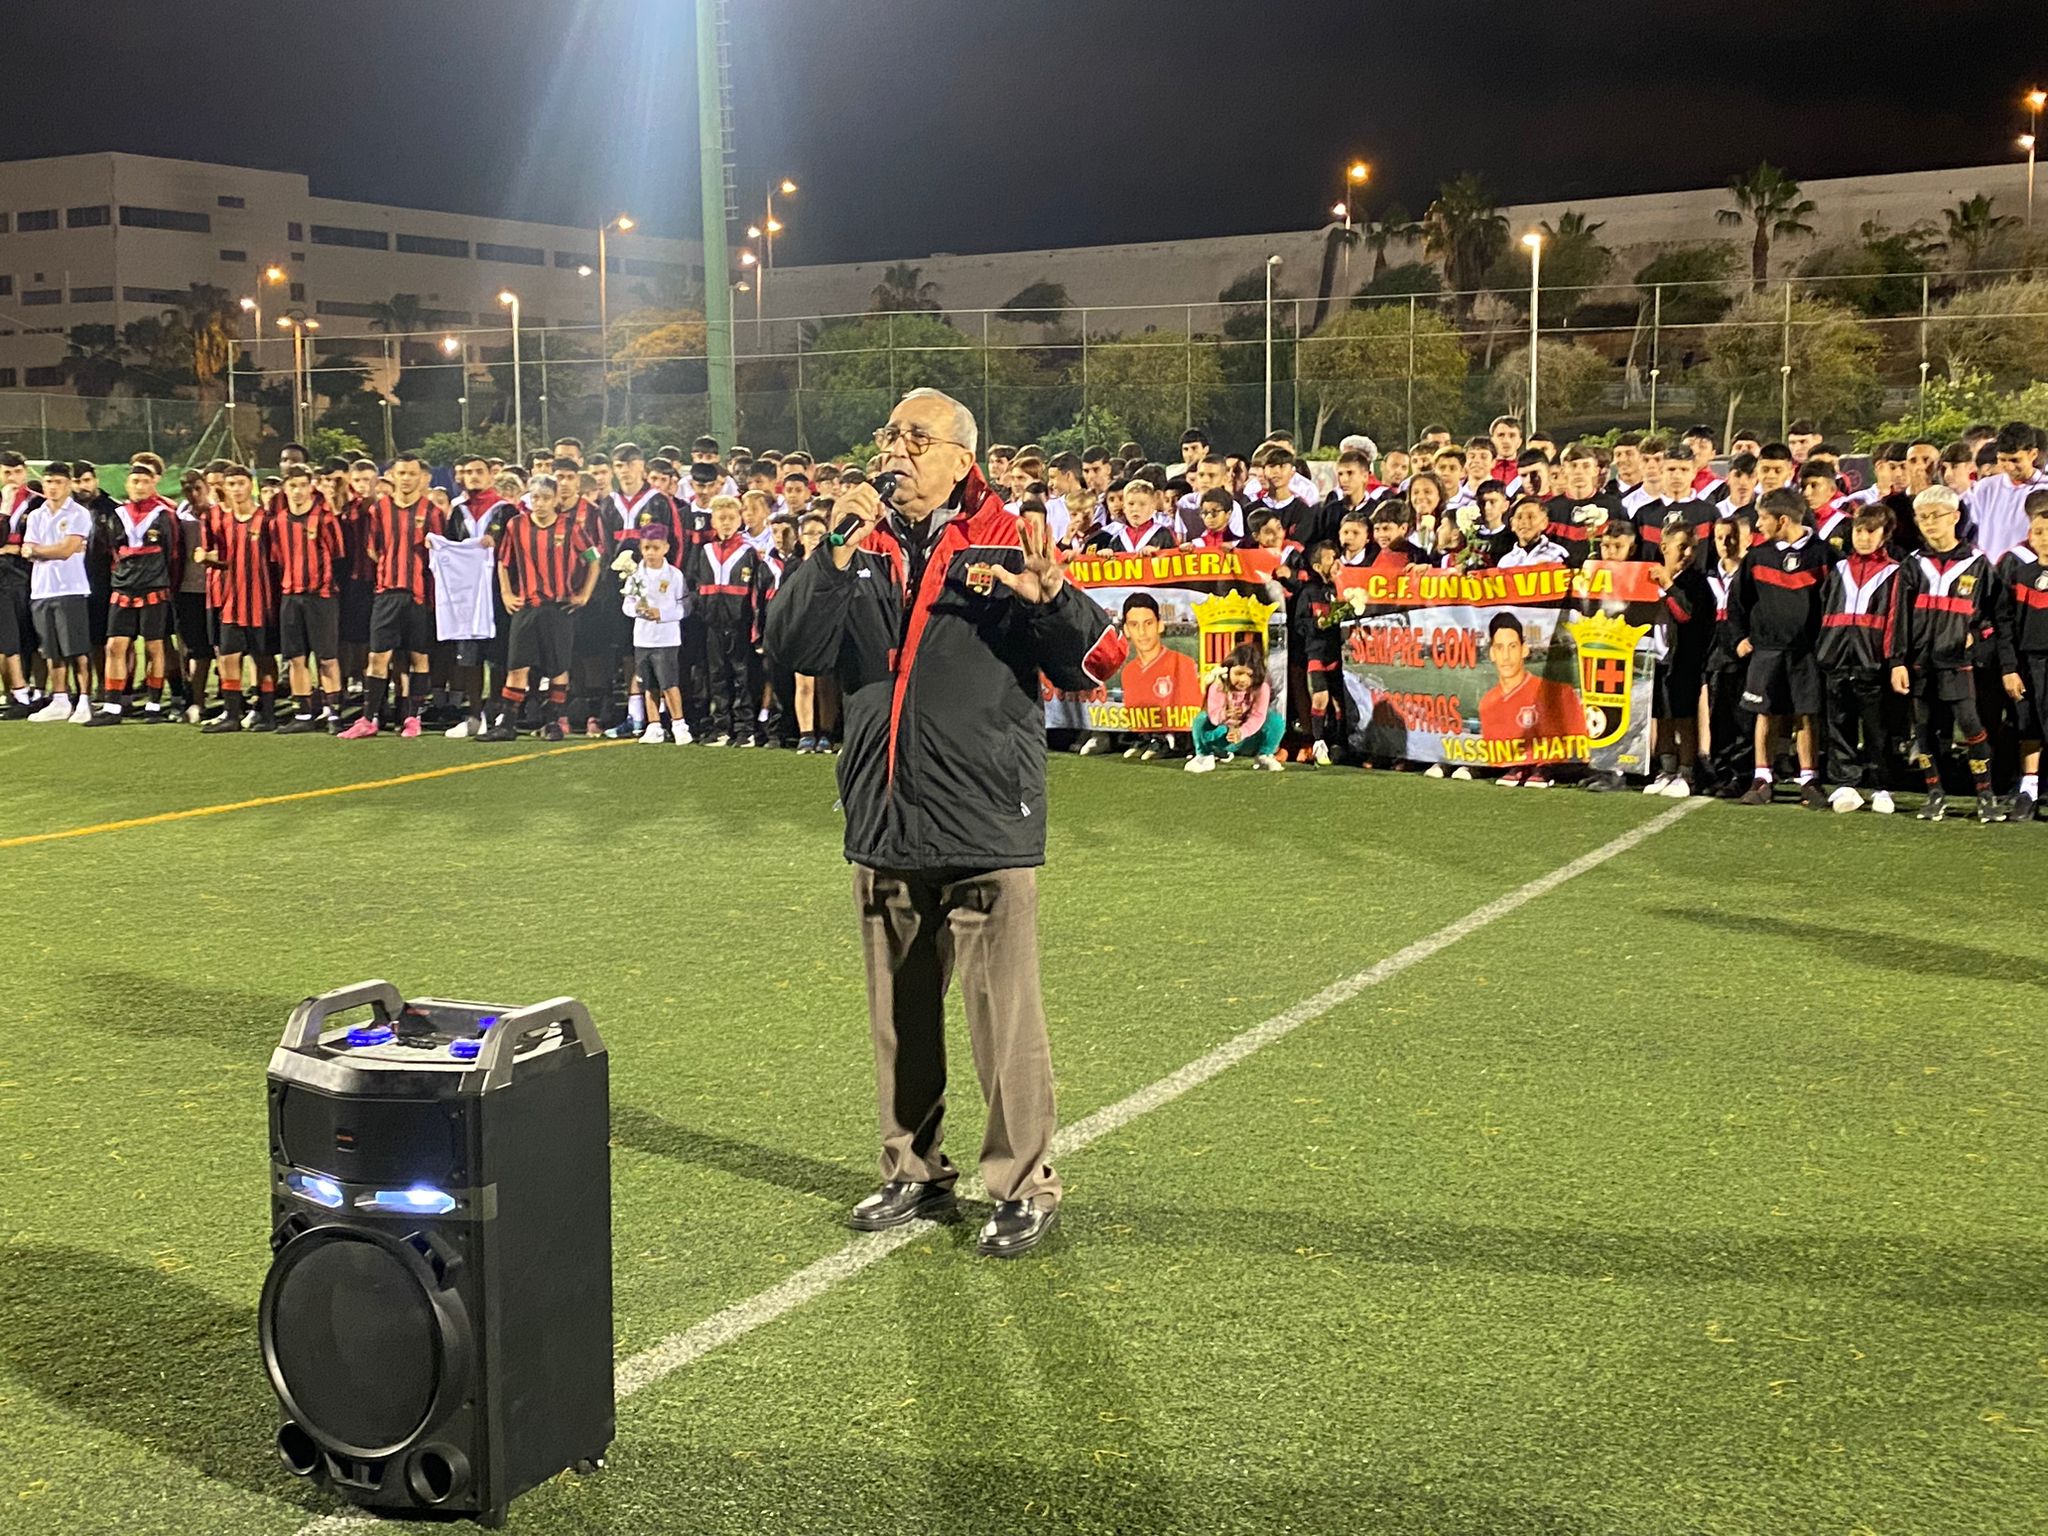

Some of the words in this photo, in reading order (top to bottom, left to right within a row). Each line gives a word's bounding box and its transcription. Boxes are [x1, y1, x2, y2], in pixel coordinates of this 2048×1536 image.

[1150, 553, 1241, 579] VIERA
[1368, 574, 1413, 599] C.F.
[1432, 626, 1477, 669] CON
[1087, 706, 1163, 729] YASSINE
[1165, 704, 1202, 728] HAT
[1441, 738, 1527, 764] YASSINE
